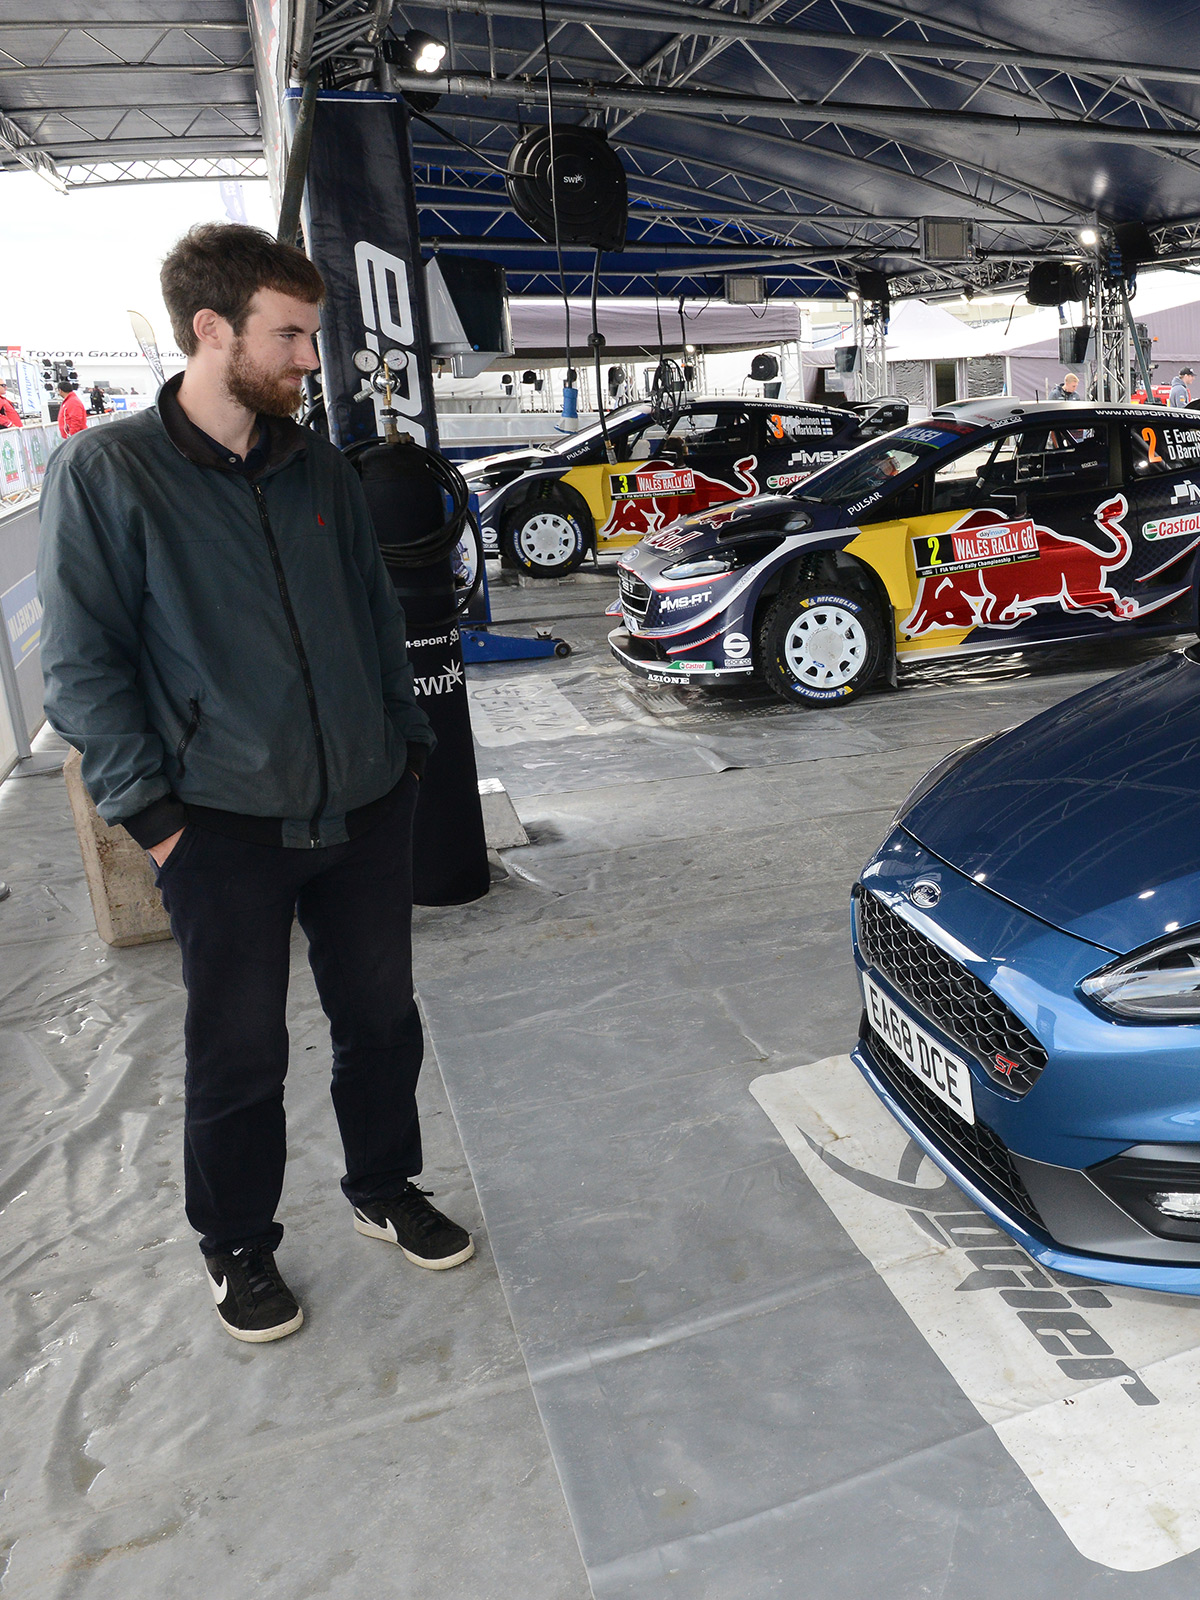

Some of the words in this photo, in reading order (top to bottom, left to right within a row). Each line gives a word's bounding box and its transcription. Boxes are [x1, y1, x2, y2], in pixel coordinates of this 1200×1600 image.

[26, 350, 84, 358] TOYOTA
[88, 350, 138, 358] GAZOO
[142, 350, 187, 360] cing
[771, 414, 784, 439] 3
[1141, 427, 1163, 463] 2
[1163, 429, 1174, 445] E
[566, 446, 591, 461] PULSAR
[1167, 445, 1177, 460] D
[619, 475, 629, 493] 3
[637, 476, 662, 492] WALES
[662, 474, 683, 490] RALLY
[682, 472, 693, 488] GB
[847, 491, 883, 517] PULSAR
[1158, 515, 1200, 537] Castrol
[927, 536, 942, 566] 2
[953, 537, 990, 560] WALES
[990, 532, 1019, 555] RALLY
[1020, 526, 1035, 550] GB
[977, 557, 1012, 568] Championship
[666, 591, 713, 611] MS-RT
[816, 596, 858, 610] MICHELIN
[685, 662, 705, 670] Castrol
[725, 658, 751, 666] sparco
[794, 685, 838, 699] MICHELIN
[869, 983, 915, 1063] EA68
[916, 1032, 963, 1108] DCE
[994, 1054, 1020, 1076] ST
